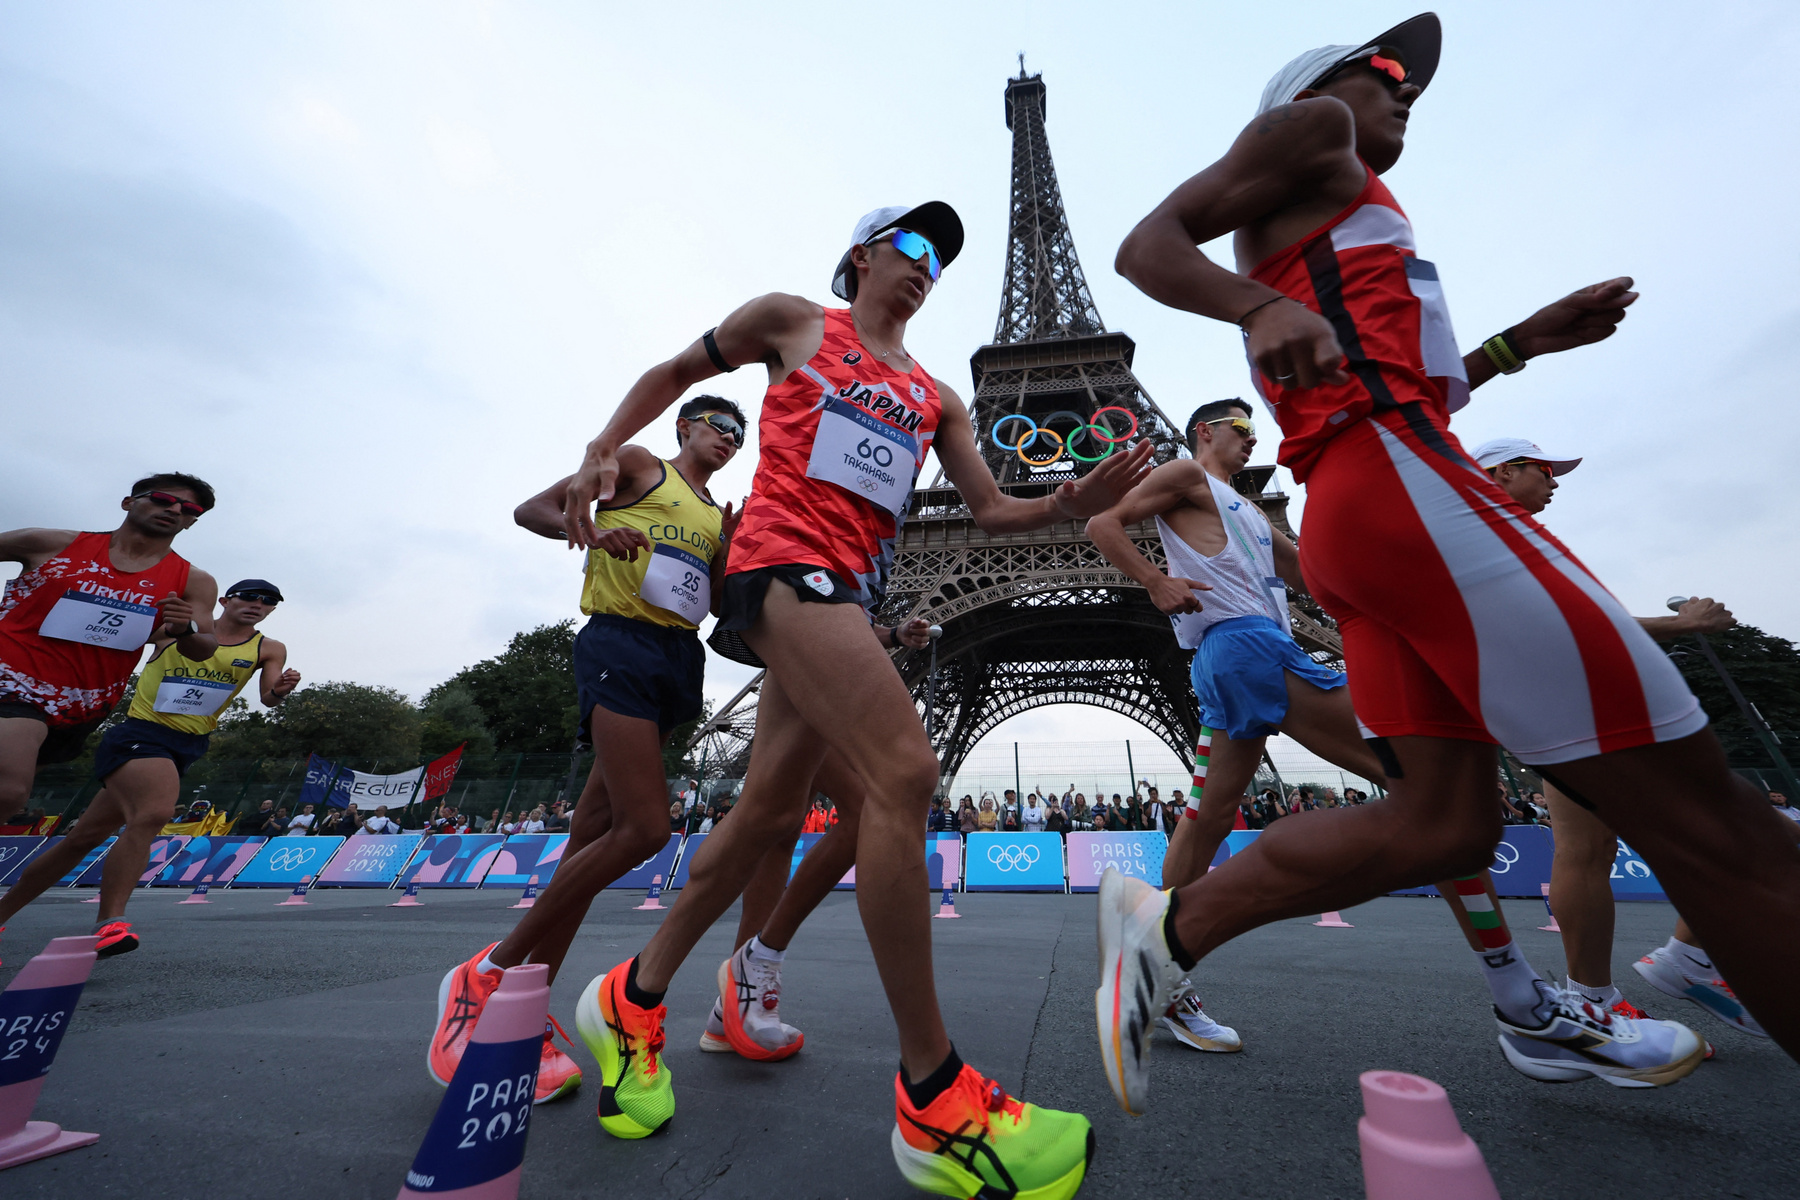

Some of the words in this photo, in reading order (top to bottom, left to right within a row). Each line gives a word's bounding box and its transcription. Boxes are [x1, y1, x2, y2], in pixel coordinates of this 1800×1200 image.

[839, 379, 924, 432] JAPAN
[884, 427, 907, 444] 2024
[856, 437, 893, 468] 60
[843, 453, 896, 487] TAKAHASHI
[649, 524, 713, 564] COLOMB
[681, 571, 700, 593] 25
[76, 580, 155, 607] ÜRKİYE
[671, 585, 699, 605] ROMERO
[98, 610, 127, 628] 75
[85, 624, 119, 636] DEMIR
[172, 698, 203, 706] HERRERA
[182, 688, 204, 700] 24
[354, 844, 398, 857] PARiS
[1091, 843, 1143, 858] PARiS
[343, 858, 387, 872] 2024
[1093, 860, 1146, 875] 2024
[457, 1101, 534, 1149] 202
